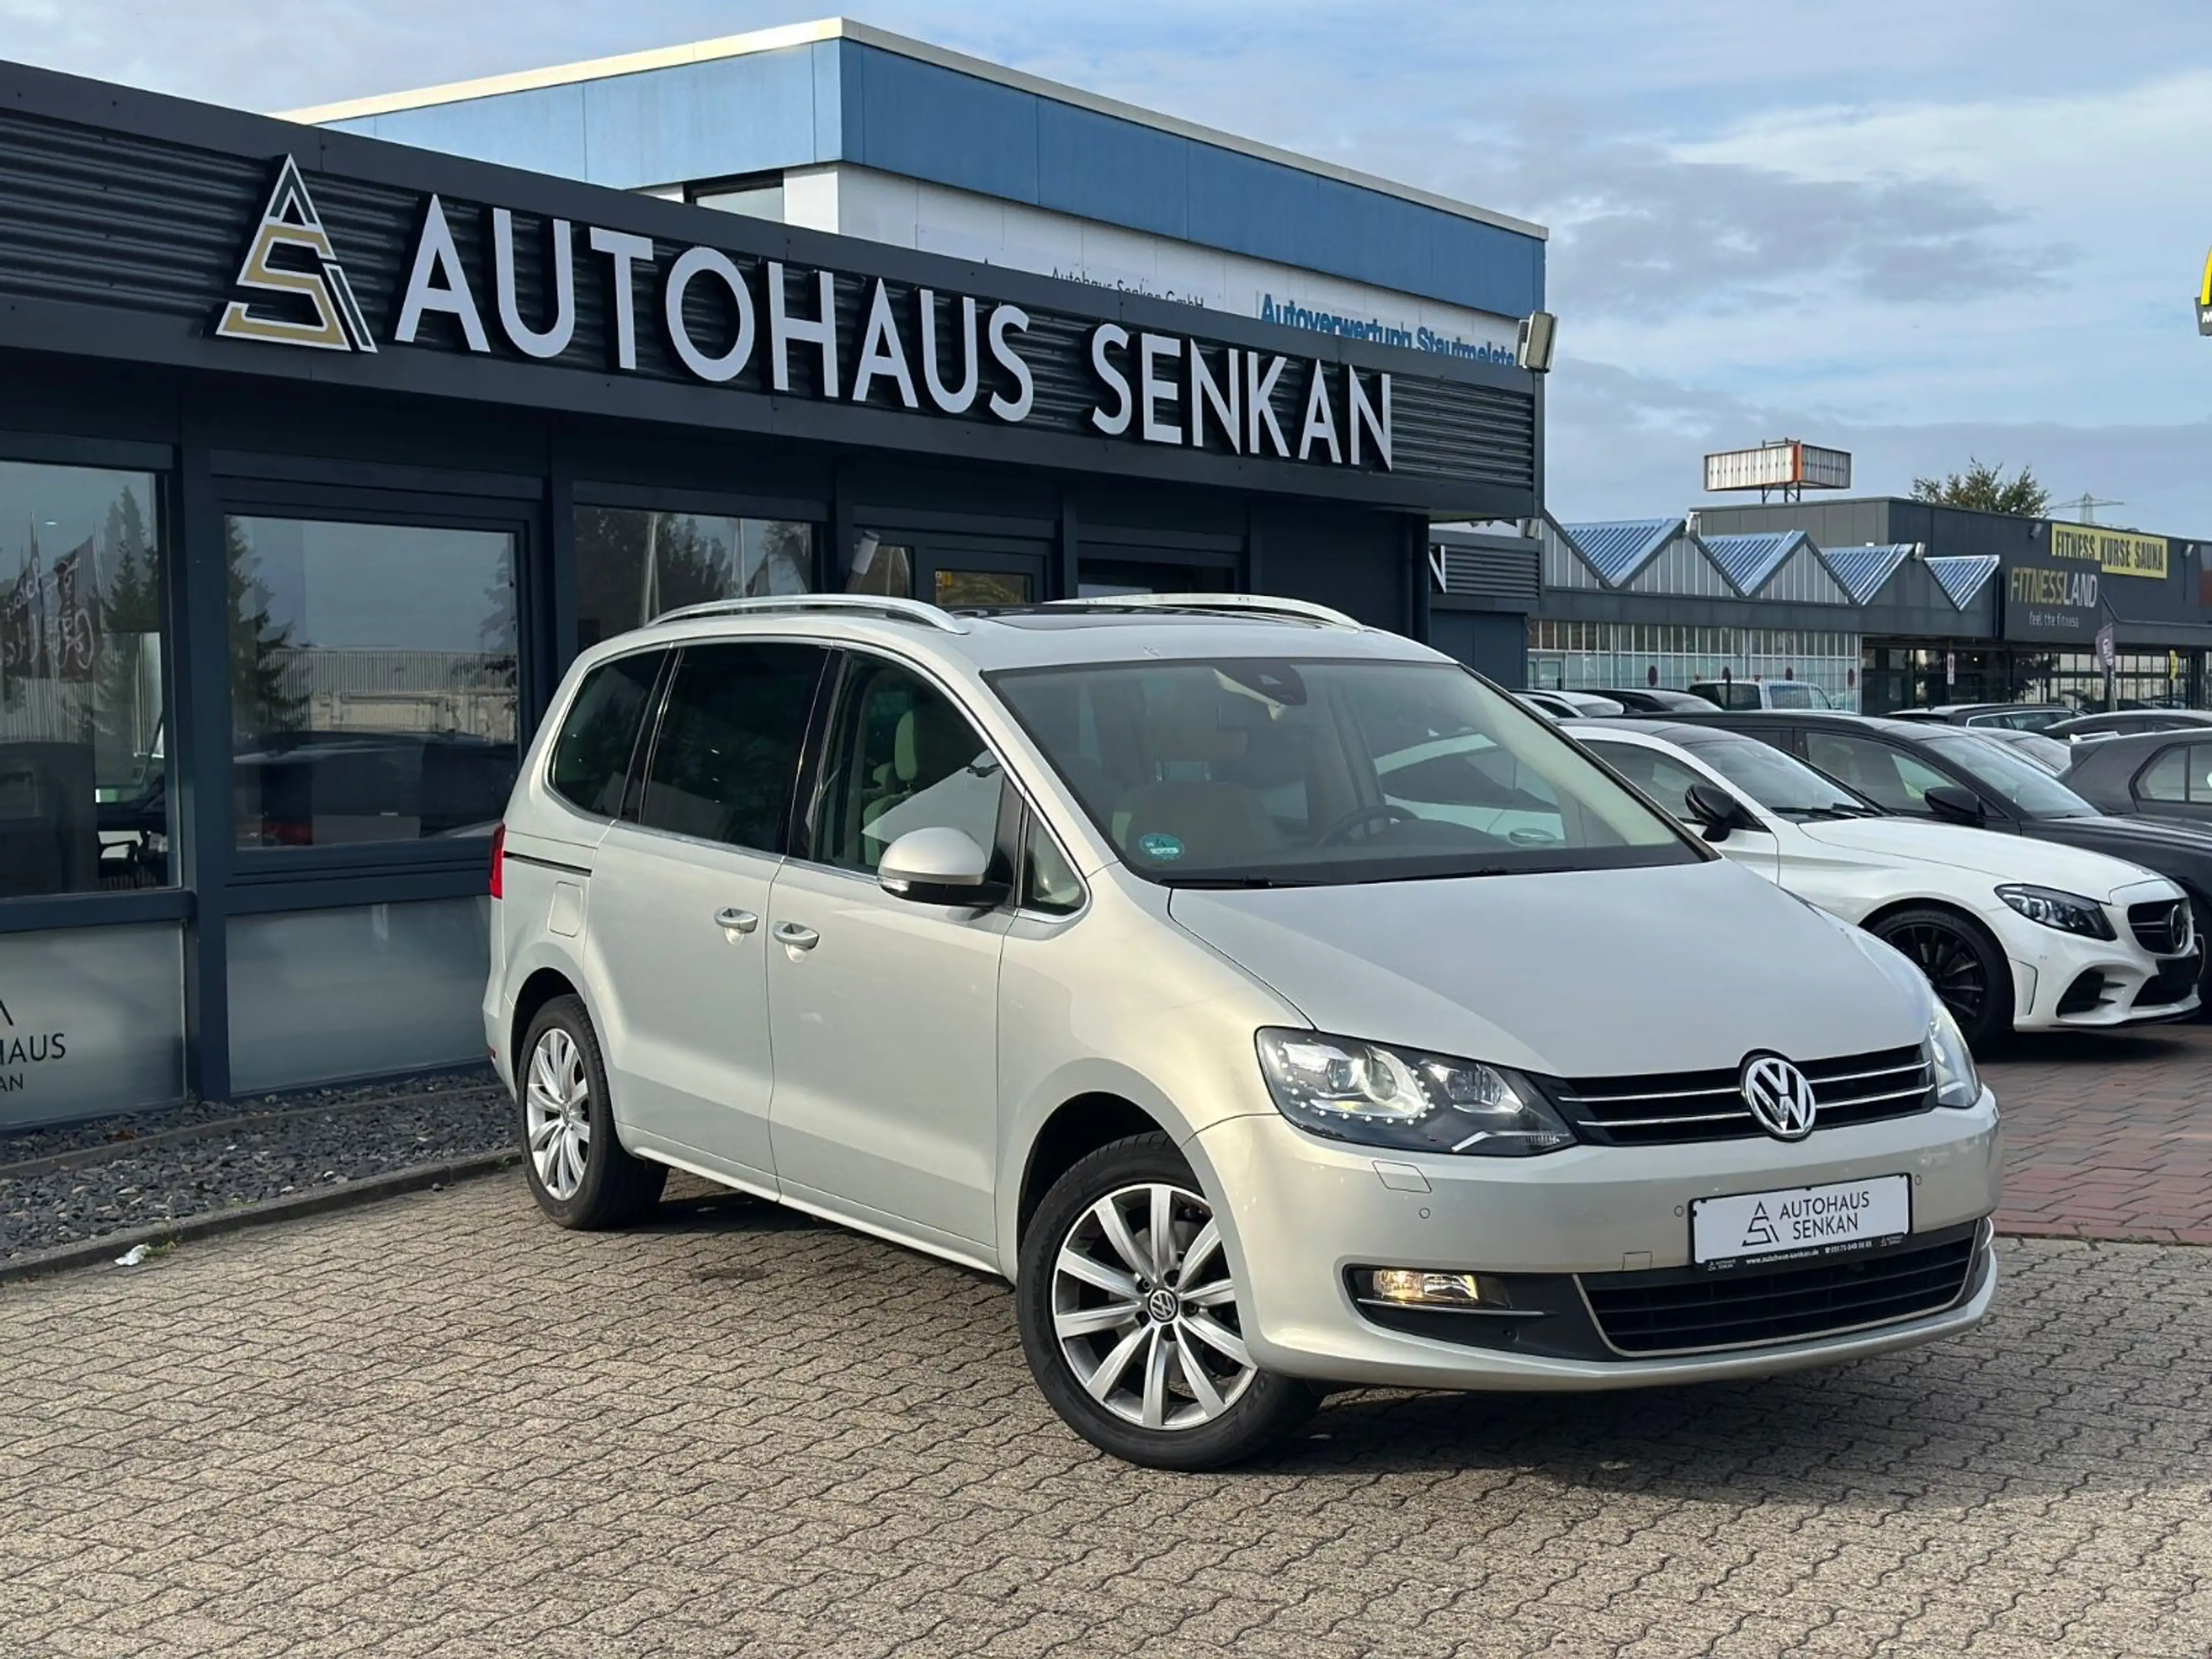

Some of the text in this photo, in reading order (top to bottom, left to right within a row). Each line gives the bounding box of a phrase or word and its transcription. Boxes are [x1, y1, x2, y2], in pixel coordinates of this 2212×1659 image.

[395, 193, 1392, 472] AUTOHAUS SENKAN
[2056, 530, 2164, 571] FITNESS KURSE SAUNA
[2010, 567, 2098, 608] FITNESSLAND
[1779, 1191, 1870, 1220] AUTOHAUS
[1793, 1213, 1858, 1240] SENKAN
